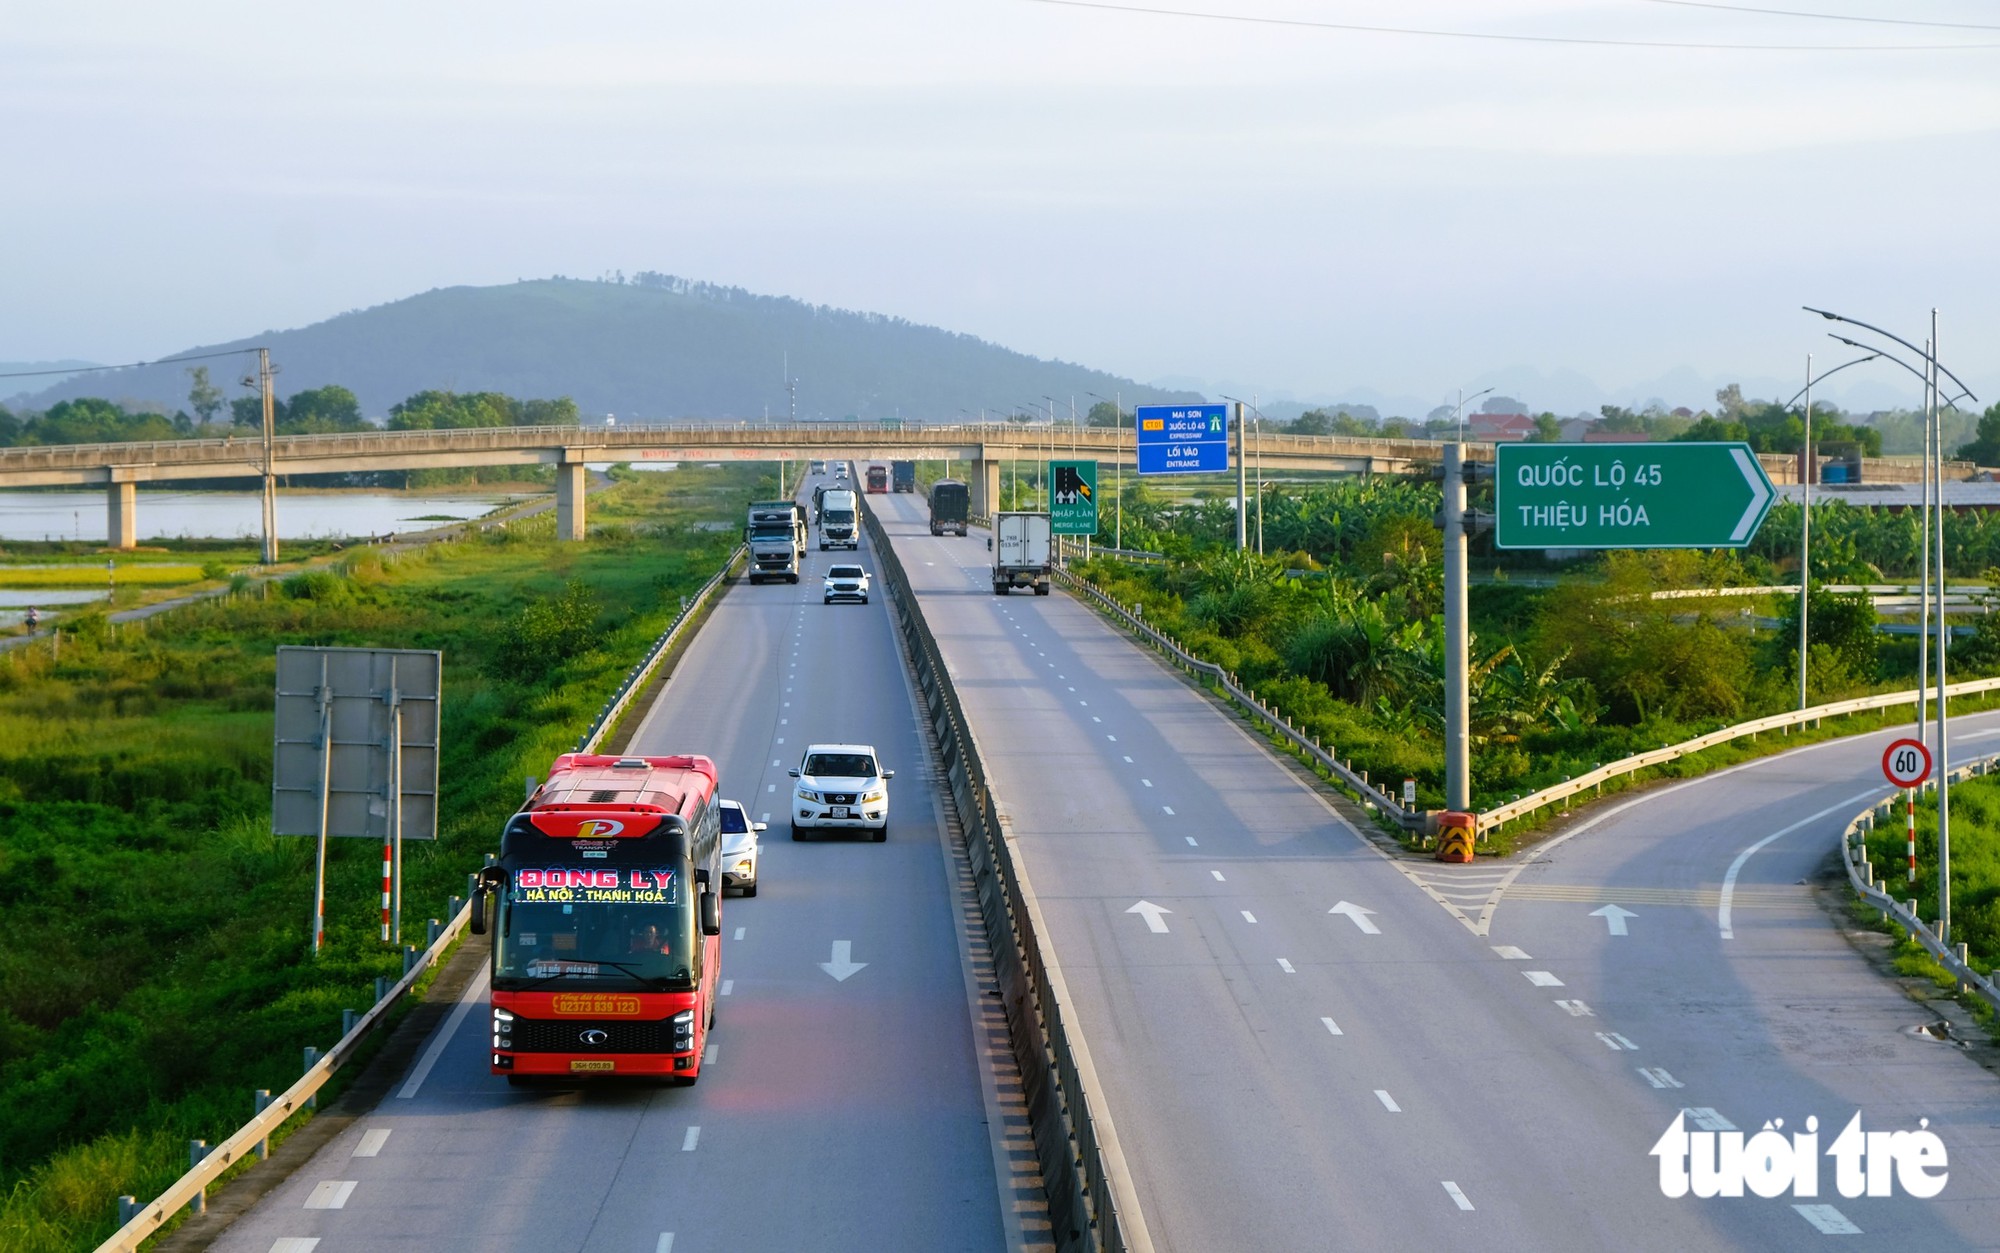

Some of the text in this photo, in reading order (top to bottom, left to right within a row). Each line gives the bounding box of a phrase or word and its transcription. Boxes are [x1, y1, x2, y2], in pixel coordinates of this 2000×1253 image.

[1172, 410, 1202, 419] MAI SƠN
[1187, 422, 1196, 431] LỘ
[1197, 422, 1206, 430] 45
[1167, 445, 1199, 457] LỐI VÀO
[1166, 460, 1200, 468] ENTRANCE
[1518, 456, 1662, 491] QUỐC LỘ 45
[1052, 507, 1094, 519] NHẬP LÀN
[1518, 497, 1651, 532] THIỆU HÓA
[1895, 750, 1916, 773] 60
[526, 888, 545, 900] HÀ
[548, 888, 574, 901] NỘI
[586, 889, 633, 901] THANH
[560, 1002, 635, 1012] 02373 839 123
